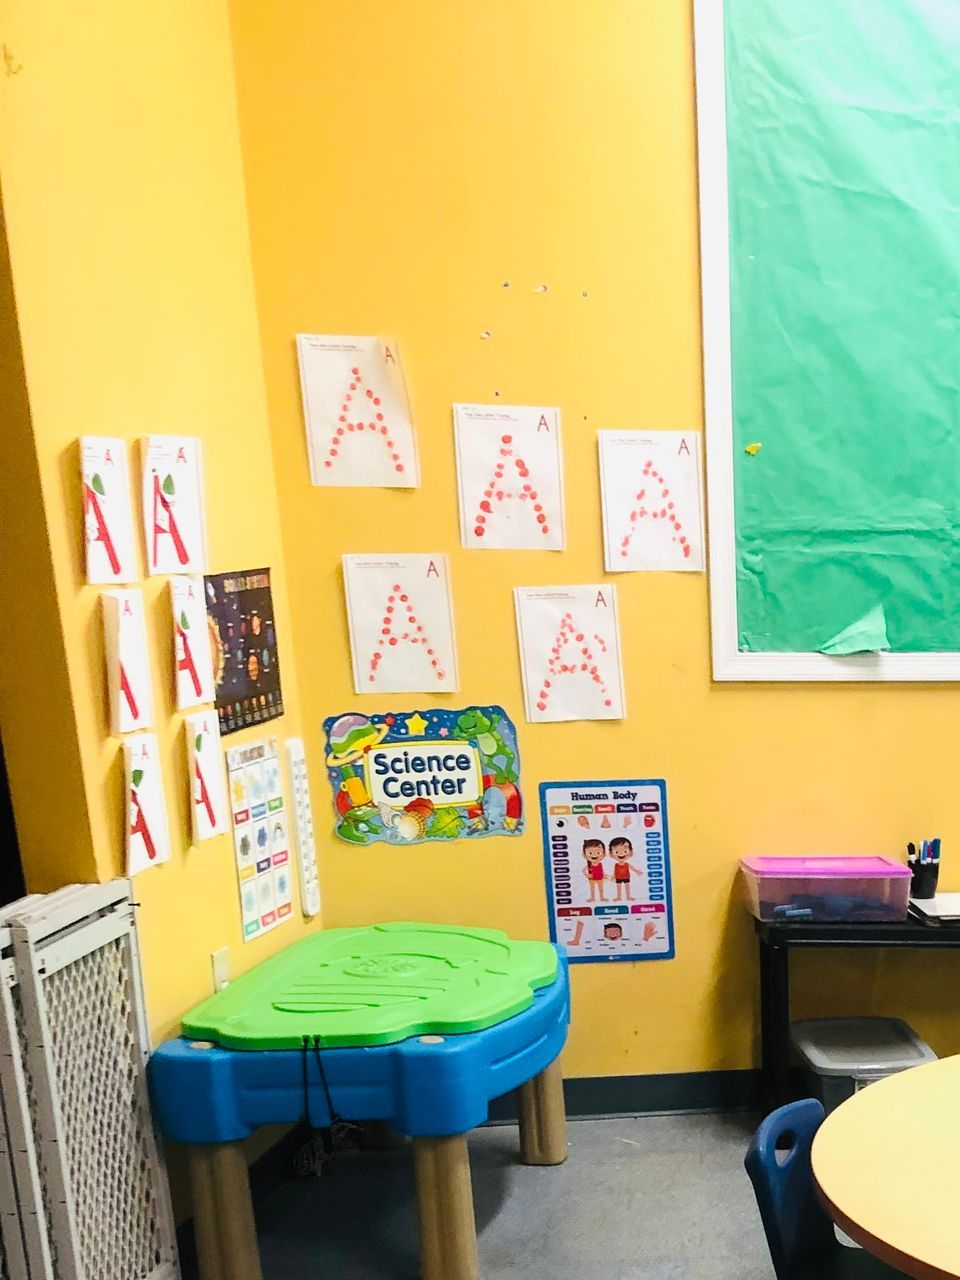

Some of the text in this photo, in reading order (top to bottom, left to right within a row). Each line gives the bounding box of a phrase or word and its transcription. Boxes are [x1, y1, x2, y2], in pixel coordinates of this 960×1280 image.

[537, 414, 550, 432] A
[678, 438, 690, 455] A
[426, 560, 440, 578] A
[595, 590, 607, 607] A
[373, 751, 471, 775] Science
[382, 774, 466, 798] Center
[570, 790, 638, 801] Human Body
